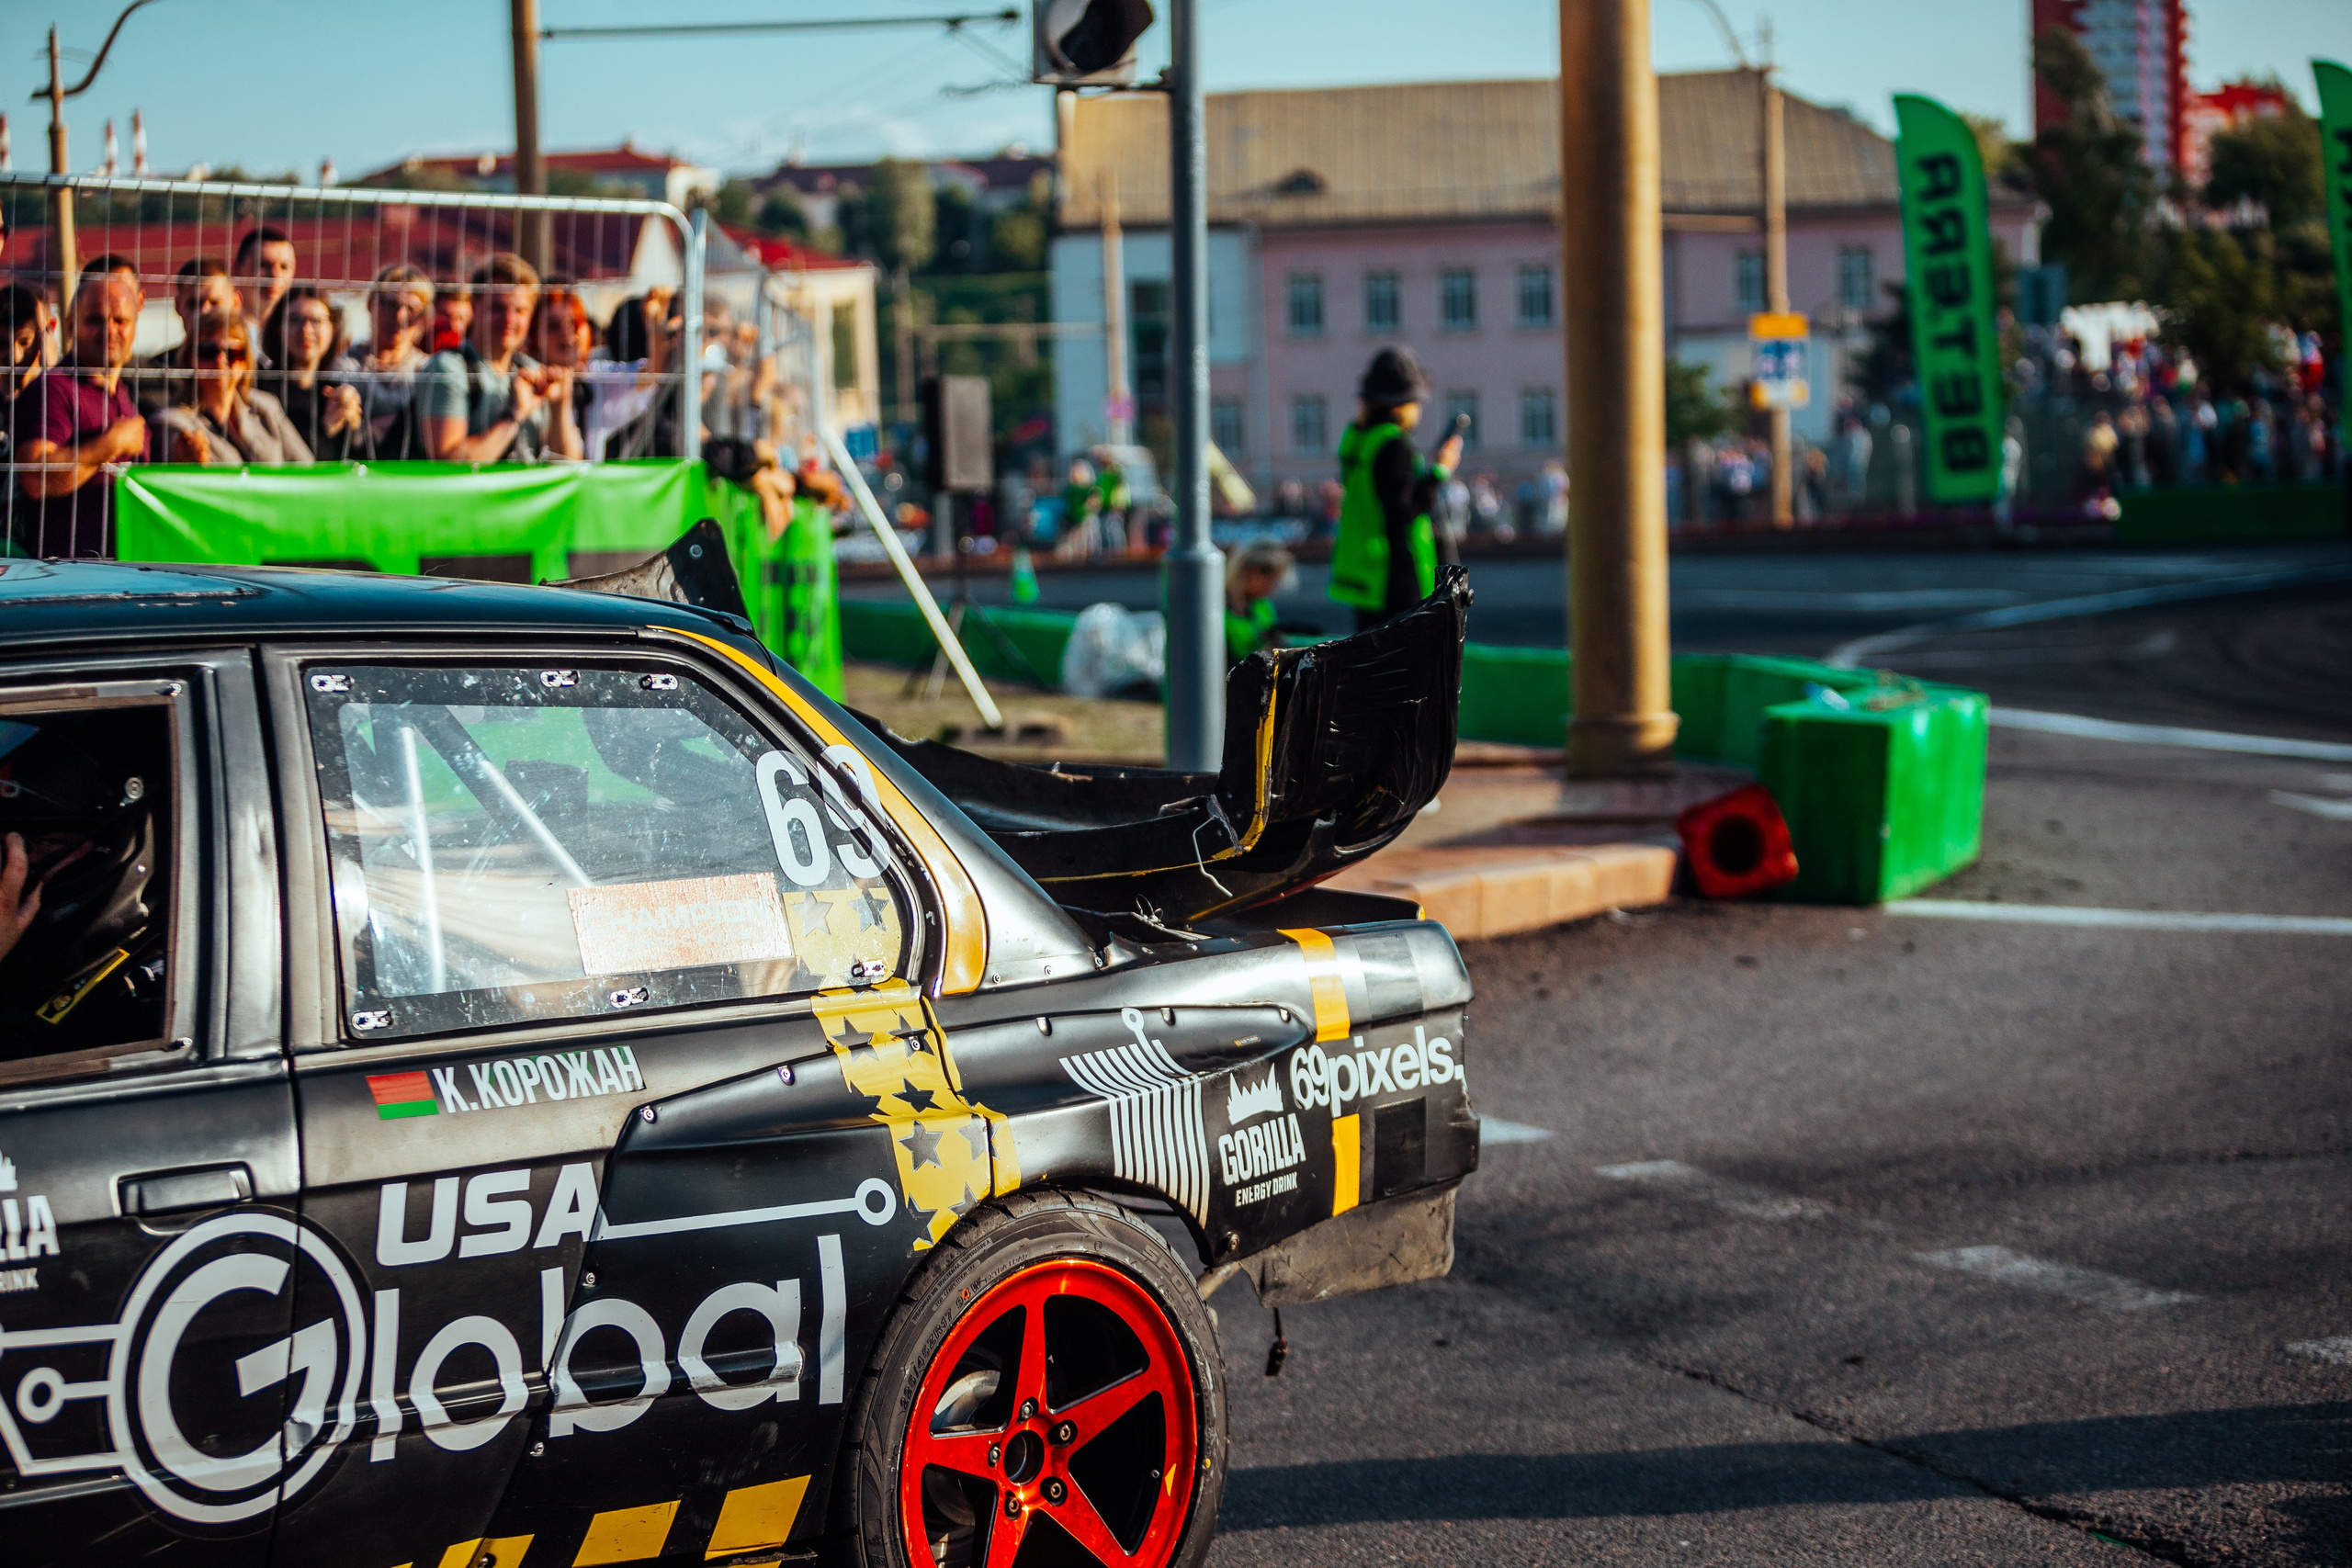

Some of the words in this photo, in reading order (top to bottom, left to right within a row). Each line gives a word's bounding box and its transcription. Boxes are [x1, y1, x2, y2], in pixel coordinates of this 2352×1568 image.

[755, 744, 891, 886] 69
[585, 897, 774, 935] CHAMPION
[432, 1046, 646, 1112] К.КОРОЖАН
[1290, 1025, 1464, 1118] 69pixels.
[1218, 1112, 1306, 1186] GORILLA
[1235, 1178, 1272, 1207] ENERGY
[1272, 1171, 1298, 1196] DRINK
[376, 1162, 602, 1266] USA
[138, 1235, 845, 1492] Global
